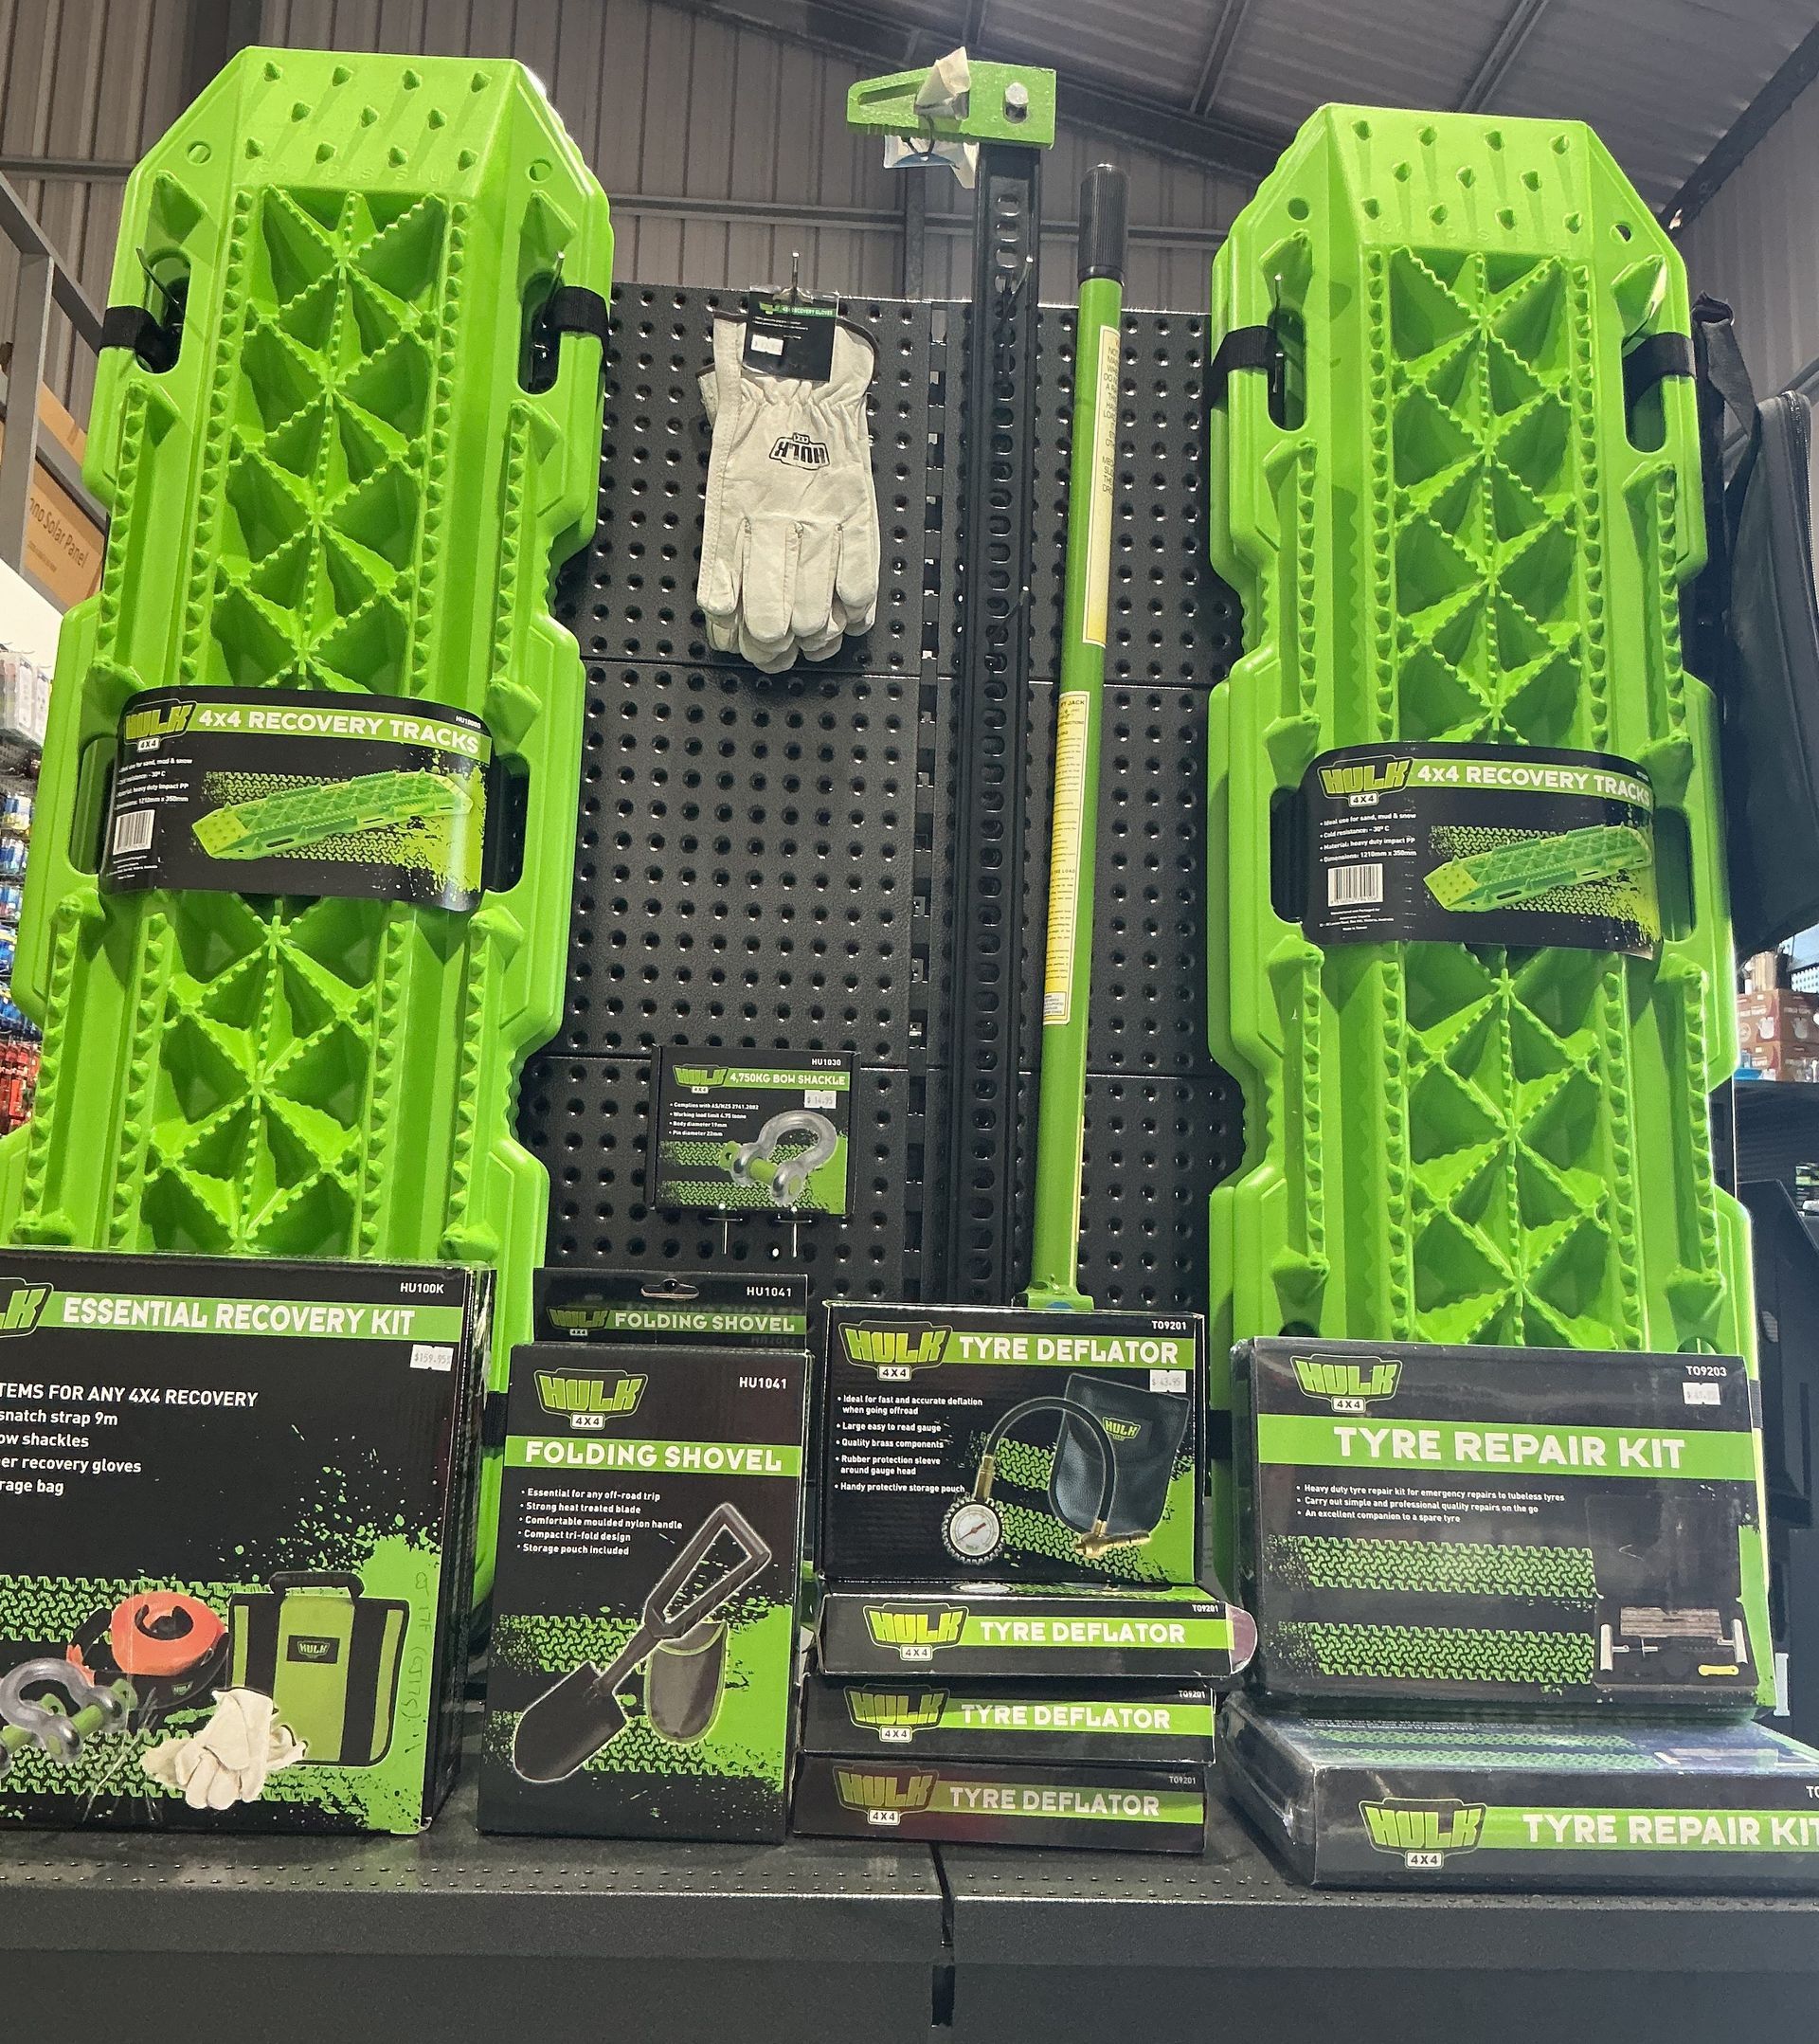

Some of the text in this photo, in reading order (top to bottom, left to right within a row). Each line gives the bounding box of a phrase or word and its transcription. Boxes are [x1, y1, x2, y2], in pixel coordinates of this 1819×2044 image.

[774, 442, 826, 464] HULK
[43, 512, 65, 545] Solar
[63, 534, 89, 569] Panel
[126, 704, 193, 740] HULK
[248, 711, 386, 736] RECOVERY
[388, 718, 479, 754] TRACKS
[1321, 759, 1411, 794] HULK
[1467, 766, 1590, 789] RECOVERY
[1594, 774, 1649, 808] TRACKS
[811, 1058, 841, 1066] HU1030
[675, 1067, 728, 1085] HULK
[773, 1075, 797, 1084] BOW
[798, 1076, 845, 1086] SHACKLE
[400, 1282, 444, 1293] HU100K
[747, 1286, 791, 1297] HU1041
[63, 1297, 208, 1329] ESSENTIAL
[215, 1304, 367, 1334] RECOVERY
[370, 1310, 416, 1335] KIT
[549, 1309, 607, 1328] HULK
[615, 1312, 795, 1332] FOLDING SHOVEL
[845, 1329, 946, 1363] HULK
[959, 1336, 1179, 1365] TYRE DEFLATOR
[882, 1367, 907, 1377] 4X4
[1294, 1361, 1398, 1396] HULK
[739, 1376, 786, 1389] HU1041
[48, 1384, 83, 1401] FOR
[86, 1385, 125, 1402] ANY
[128, 1387, 160, 1403] 4X4
[165, 1388, 259, 1406] RECOVERY
[539, 1374, 642, 1411] HULK
[843, 1394, 863, 1402] Ideal
[864, 1395, 878, 1403] for
[877, 1395, 893, 1403] fast
[894, 1395, 910, 1404] and
[946, 1397, 982, 1406] deflation
[842, 1405, 864, 1414] when
[865, 1405, 888, 1416] going
[1337, 1401, 1360, 1410] 4X4
[50, 1410, 90, 1427] strap
[95, 1411, 117, 1425] 9m
[575, 1417, 600, 1426] 4X4
[842, 1421, 866, 1432] Large
[867, 1423, 886, 1432] easy
[896, 1422, 915, 1431] read
[916, 1423, 942, 1433] gauge
[1105, 1420, 1138, 1437] HULK
[21, 1432, 89, 1447] shackles
[841, 1438, 945, 1449] Quality brass components
[1333, 1426, 1684, 1468] TYRE REPAIR KIT
[22, 1458, 89, 1474] recovery
[92, 1457, 141, 1474] gloves
[525, 1441, 782, 1472] FOLDING SHOVEL
[841, 1454, 941, 1468] Rubber protection sleeve
[840, 1465, 916, 1476] around gauge head
[36, 1478, 63, 1496] bag
[527, 1487, 660, 1502] Essential for any off-road trip
[840, 1481, 965, 1493] Handy protective storage pouch
[1304, 1484, 1565, 1502] Heavy duty tyre repair kit for emergency repairs to tubeless tyres
[526, 1501, 640, 1514] Strong heat treated blade
[1305, 1495, 1328, 1507] Carry
[1343, 1498, 1372, 1508] simple
[1389, 1499, 1440, 1510] professional
[1441, 1502, 1469, 1512] quality
[1470, 1502, 1501, 1512] repairs
[1513, 1504, 1526, 1512] the
[1527, 1506, 1539, 1514] go
[525, 1515, 682, 1529] Comfortable moulded nylon handle
[1305, 1509, 1316, 1517] An
[1317, 1510, 1356, 1518] excellent
[1357, 1511, 1401, 1520] companion
[1401, 1512, 1411, 1521] to
[1418, 1514, 1442, 1523] spare
[1443, 1514, 1461, 1524] tyre
[524, 1528, 631, 1543] Compact tri-fold design
[522, 1543, 629, 1555] Storage pouch included
[869, 1611, 963, 1643] HULK
[981, 1622, 1186, 1644] TYRE DEFLATOR
[298, 1643, 328, 1655] HULK
[850, 1691, 944, 1725] HULK
[962, 1705, 1171, 1729] TYRE DEFLATOR
[838, 1774, 933, 1806] HULK
[949, 1788, 1160, 1817] TYRE DEFLATOR
[1365, 1807, 1483, 1848] HULK
[1522, 1814, 1617, 1843] TYRE
[1629, 1815, 1759, 1846] REPAIR
[1410, 1855, 1438, 1865] 4X4
